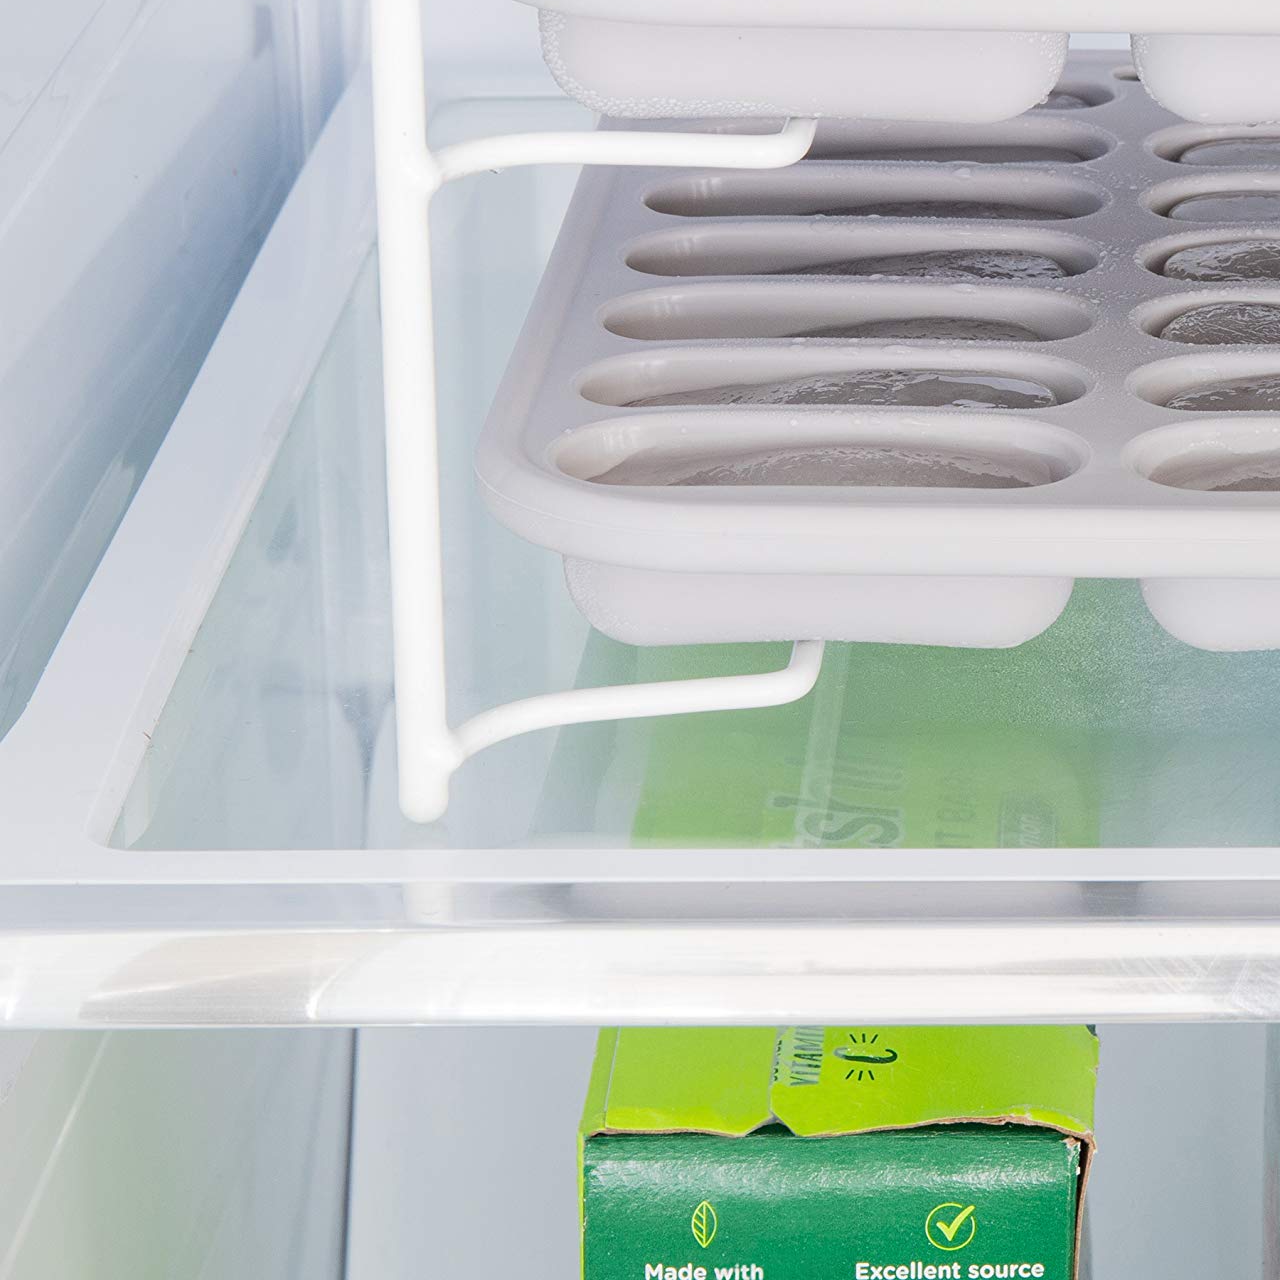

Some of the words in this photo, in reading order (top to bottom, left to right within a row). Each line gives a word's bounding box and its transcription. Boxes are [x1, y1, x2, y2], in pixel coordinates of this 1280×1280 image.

[644, 1263, 707, 1280] Made
[713, 1263, 765, 1280] with
[855, 1261, 961, 1280] Excellent
[967, 1262, 1045, 1280] source
